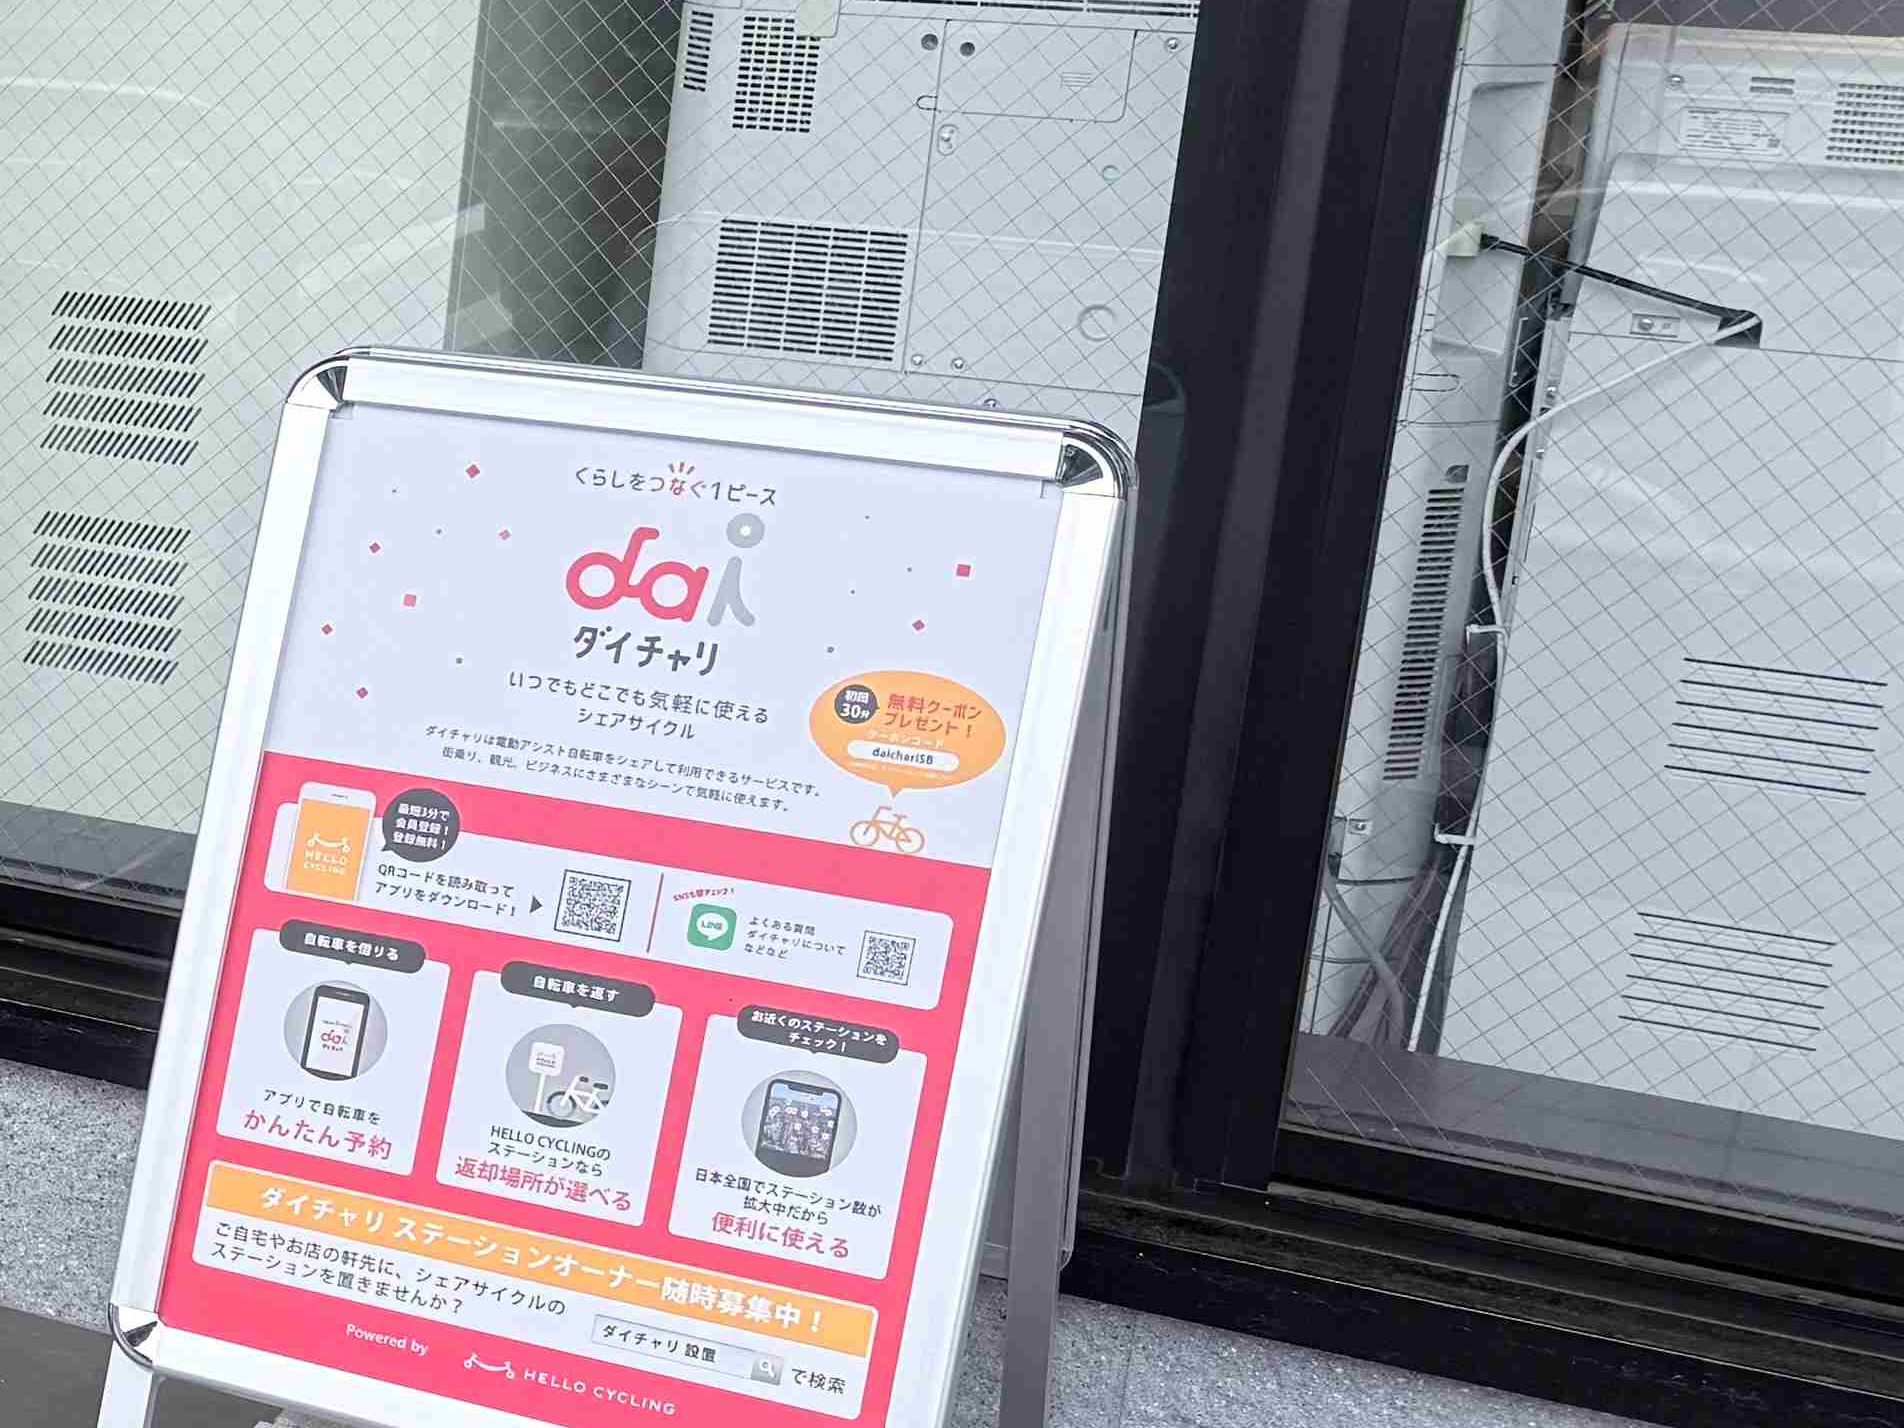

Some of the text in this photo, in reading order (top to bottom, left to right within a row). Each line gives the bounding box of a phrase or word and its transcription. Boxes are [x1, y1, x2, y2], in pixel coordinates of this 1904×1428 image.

[575, 466, 777, 506] くらしをつなぐ1ピース
[573, 625, 719, 677] ダイチャリ
[508, 670, 769, 724] いつでもどこでも気軽に使える
[839, 703, 870, 720] 30分
[844, 690, 870, 704] 初回
[887, 693, 984, 721] 無料クーポン
[577, 707, 696, 741] シェアサイクル
[866, 728, 945, 748] クーポンコード
[303, 849, 349, 866] HELLO
[378, 863, 515, 898] QRコードを読み取って
[700, 920, 724, 931] LINE
[747, 929, 848, 956] ダイチャリについて
[749, 916, 816, 936] よくある質問
[303, 932, 400, 961] 自転車を借りる
[744, 943, 791, 959] などなど
[533, 975, 620, 1003] 自転車を返す
[751, 1010, 888, 1047] お近くのステーションを
[263, 1088, 382, 1126] アプリで自転車を
[243, 1109, 393, 1162] かんたん予約
[490, 1124, 611, 1161] HELLO CYCLINGの
[487, 1141, 604, 1177] ステーションなら
[454, 1155, 632, 1212] 返却場所が選べる
[694, 1167, 882, 1218] 日本全国でステーション数が
[743, 1195, 829, 1226] 拡大中だから
[711, 1210, 849, 1259] 便利に使える
[214, 1221, 566, 1317] ご自宅やお店の軒先に、シェアサイクルの
[345, 1322, 429, 1357] Powered by
[601, 1323, 847, 1396] ダイチャリ 設置 で検索
[523, 1367, 677, 1416] HELLO CYCLING
